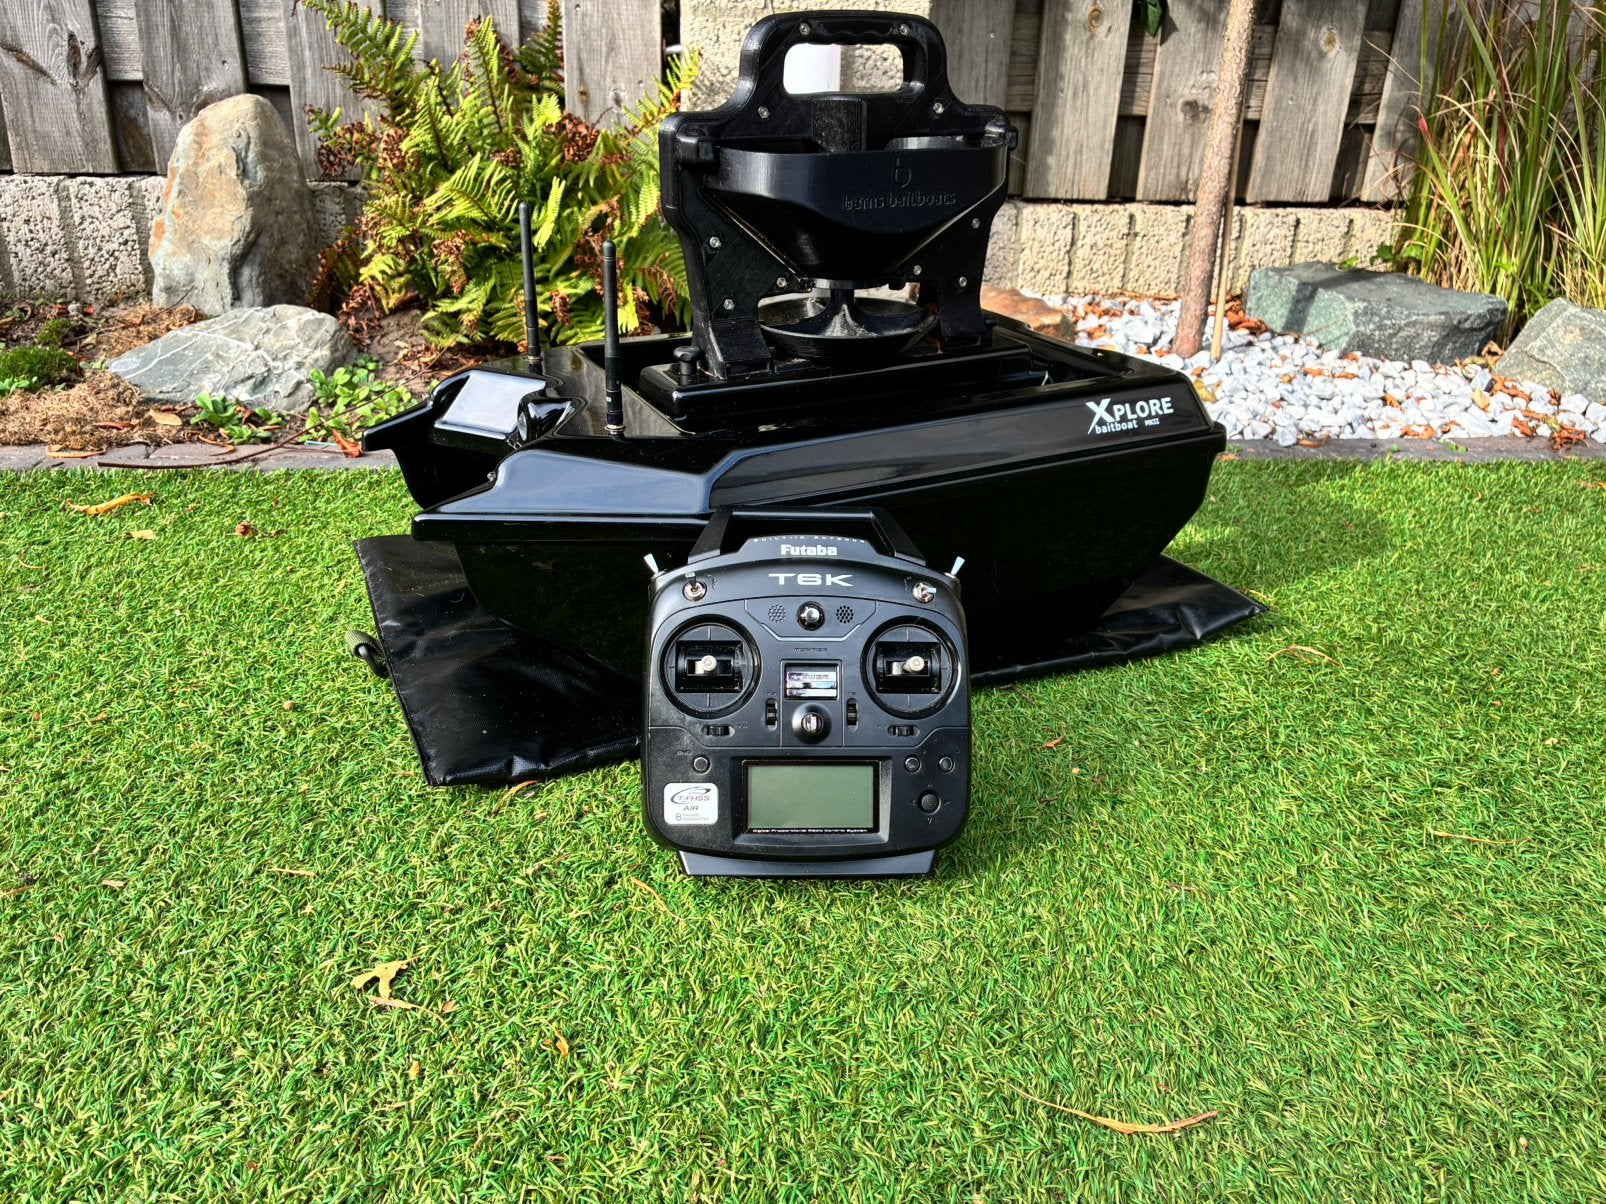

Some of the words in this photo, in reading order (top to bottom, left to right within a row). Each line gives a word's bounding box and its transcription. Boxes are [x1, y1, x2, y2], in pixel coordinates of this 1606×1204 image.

[888, 190, 956, 207] baitboats
[1085, 397, 1174, 435] XPLORE
[1094, 419, 1138, 435] baitboat
[814, 535, 865, 543] ANTENNA
[780, 544, 838, 556] Futaba
[768, 573, 854, 587] T6K
